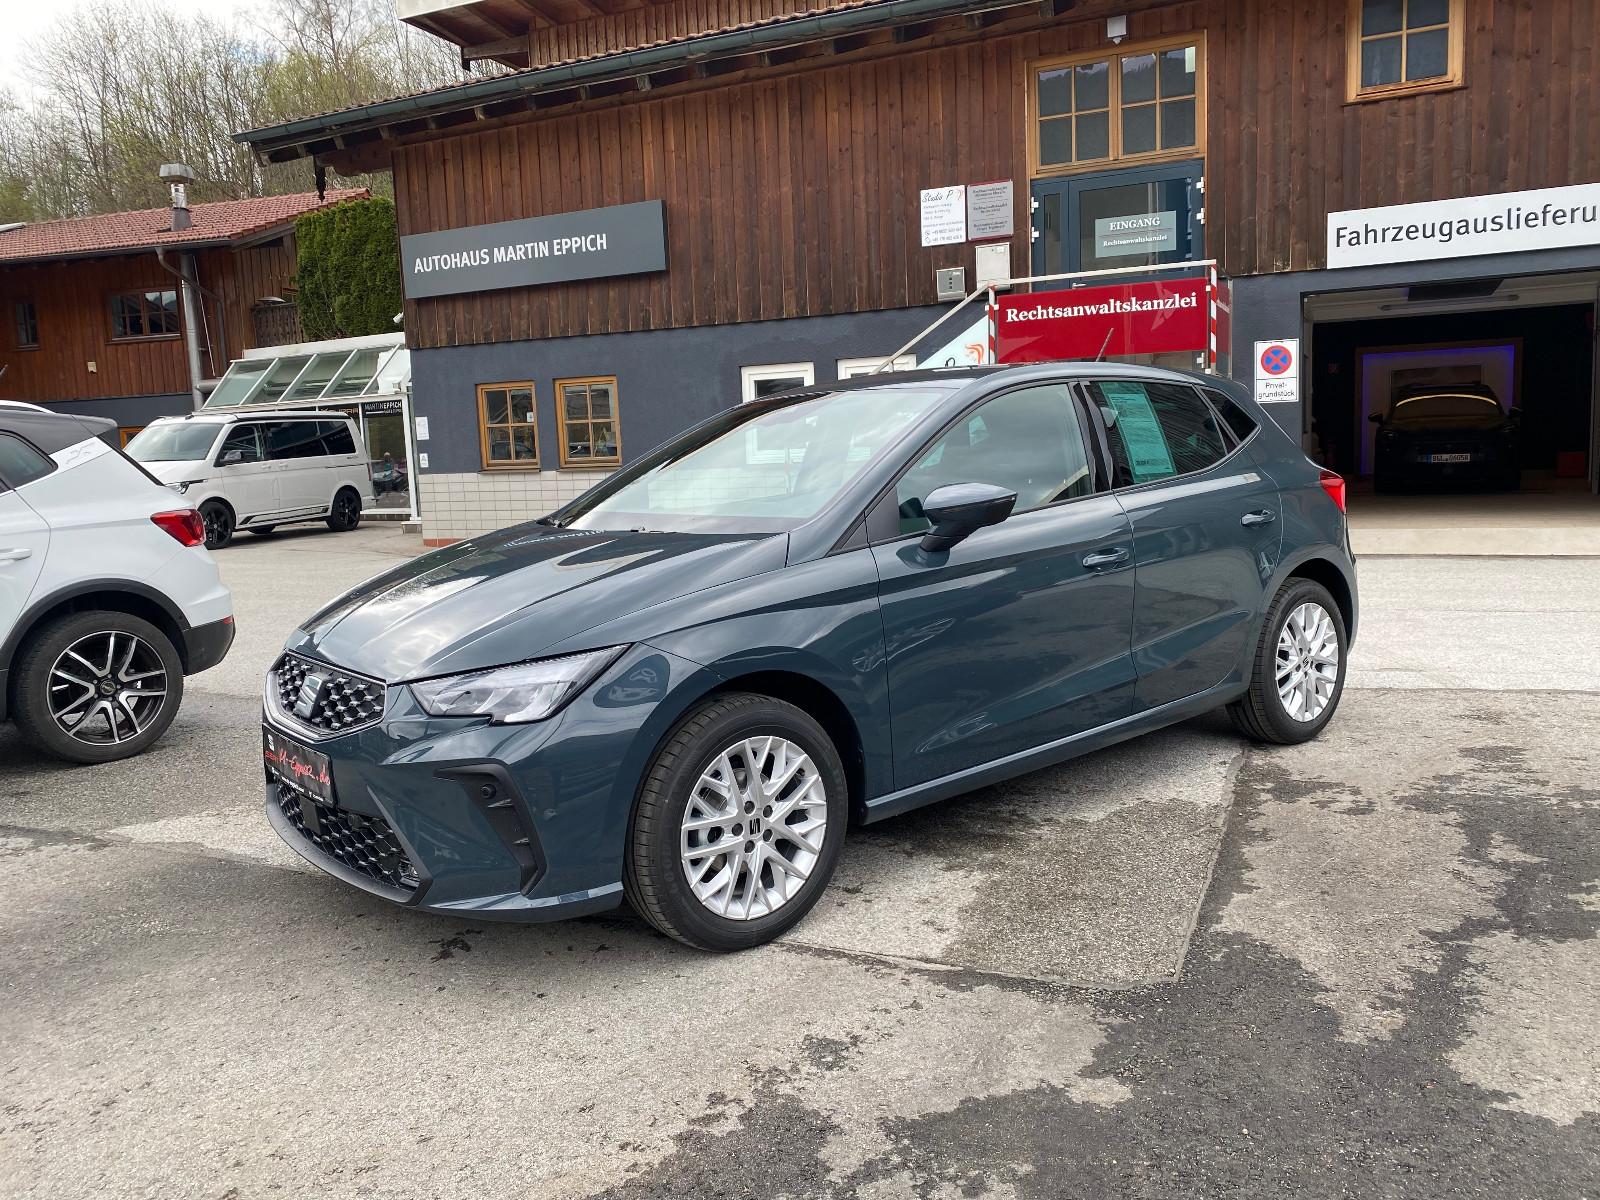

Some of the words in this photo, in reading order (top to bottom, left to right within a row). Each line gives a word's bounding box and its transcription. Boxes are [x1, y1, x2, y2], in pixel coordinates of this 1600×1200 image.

[1109, 216, 1161, 231] EINGANG
[1336, 203, 1598, 248] Fahrzeugauslieferu
[1103, 234, 1168, 247] Rechtsanwaltskanzlei
[414, 248, 490, 274] AUTOHAUS
[493, 240, 550, 264] MARTIN
[553, 233, 608, 256] EPPICH
[1006, 292, 1197, 323] Rechtsanwaltskanzlei
[1258, 390, 1295, 400] grundstück
